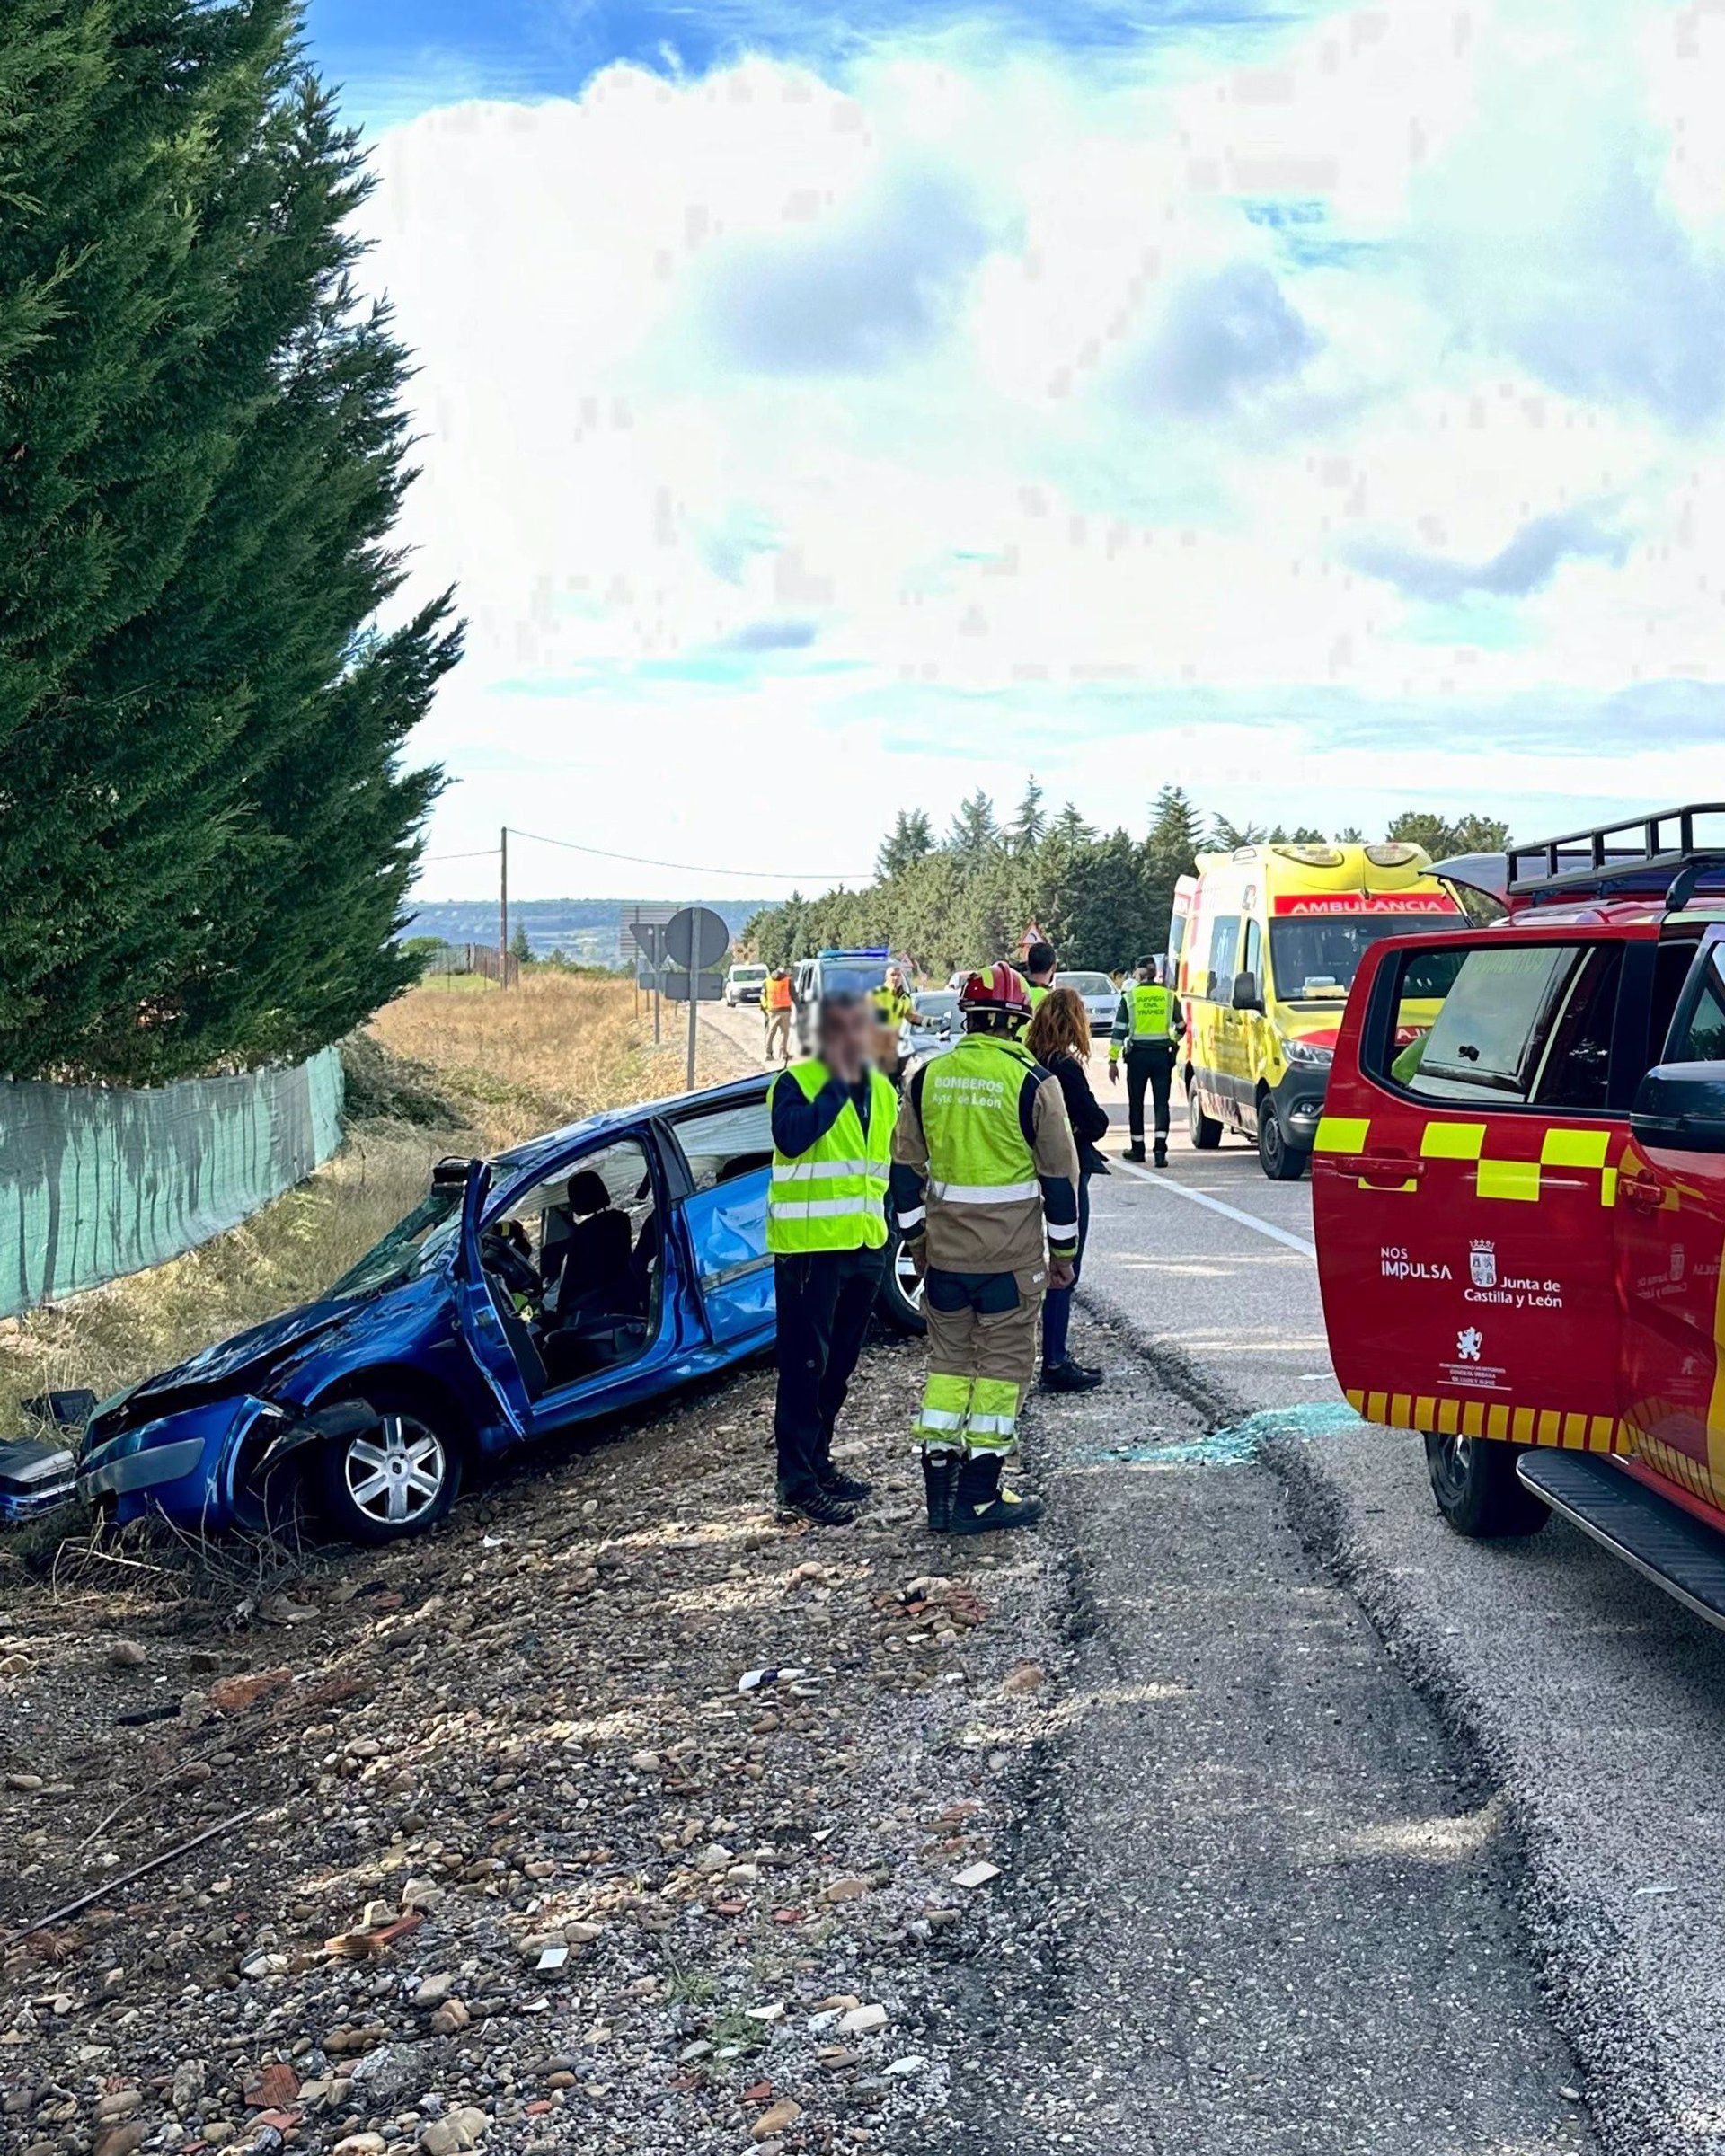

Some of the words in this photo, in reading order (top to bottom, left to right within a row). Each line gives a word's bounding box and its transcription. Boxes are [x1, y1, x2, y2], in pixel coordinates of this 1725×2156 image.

[1291, 899, 1442, 914] AMBULANCIA
[934, 1077, 1004, 1093] BOMBEROS
[1380, 1247, 1409, 1259] NOS
[1381, 1260, 1454, 1280] IMPULSA
[1499, 1276, 1540, 1291] Junta
[1543, 1279, 1561, 1293] de
[1464, 1288, 1513, 1304] Castilla
[1515, 1294, 1526, 1309] y
[1528, 1293, 1563, 1308] León
